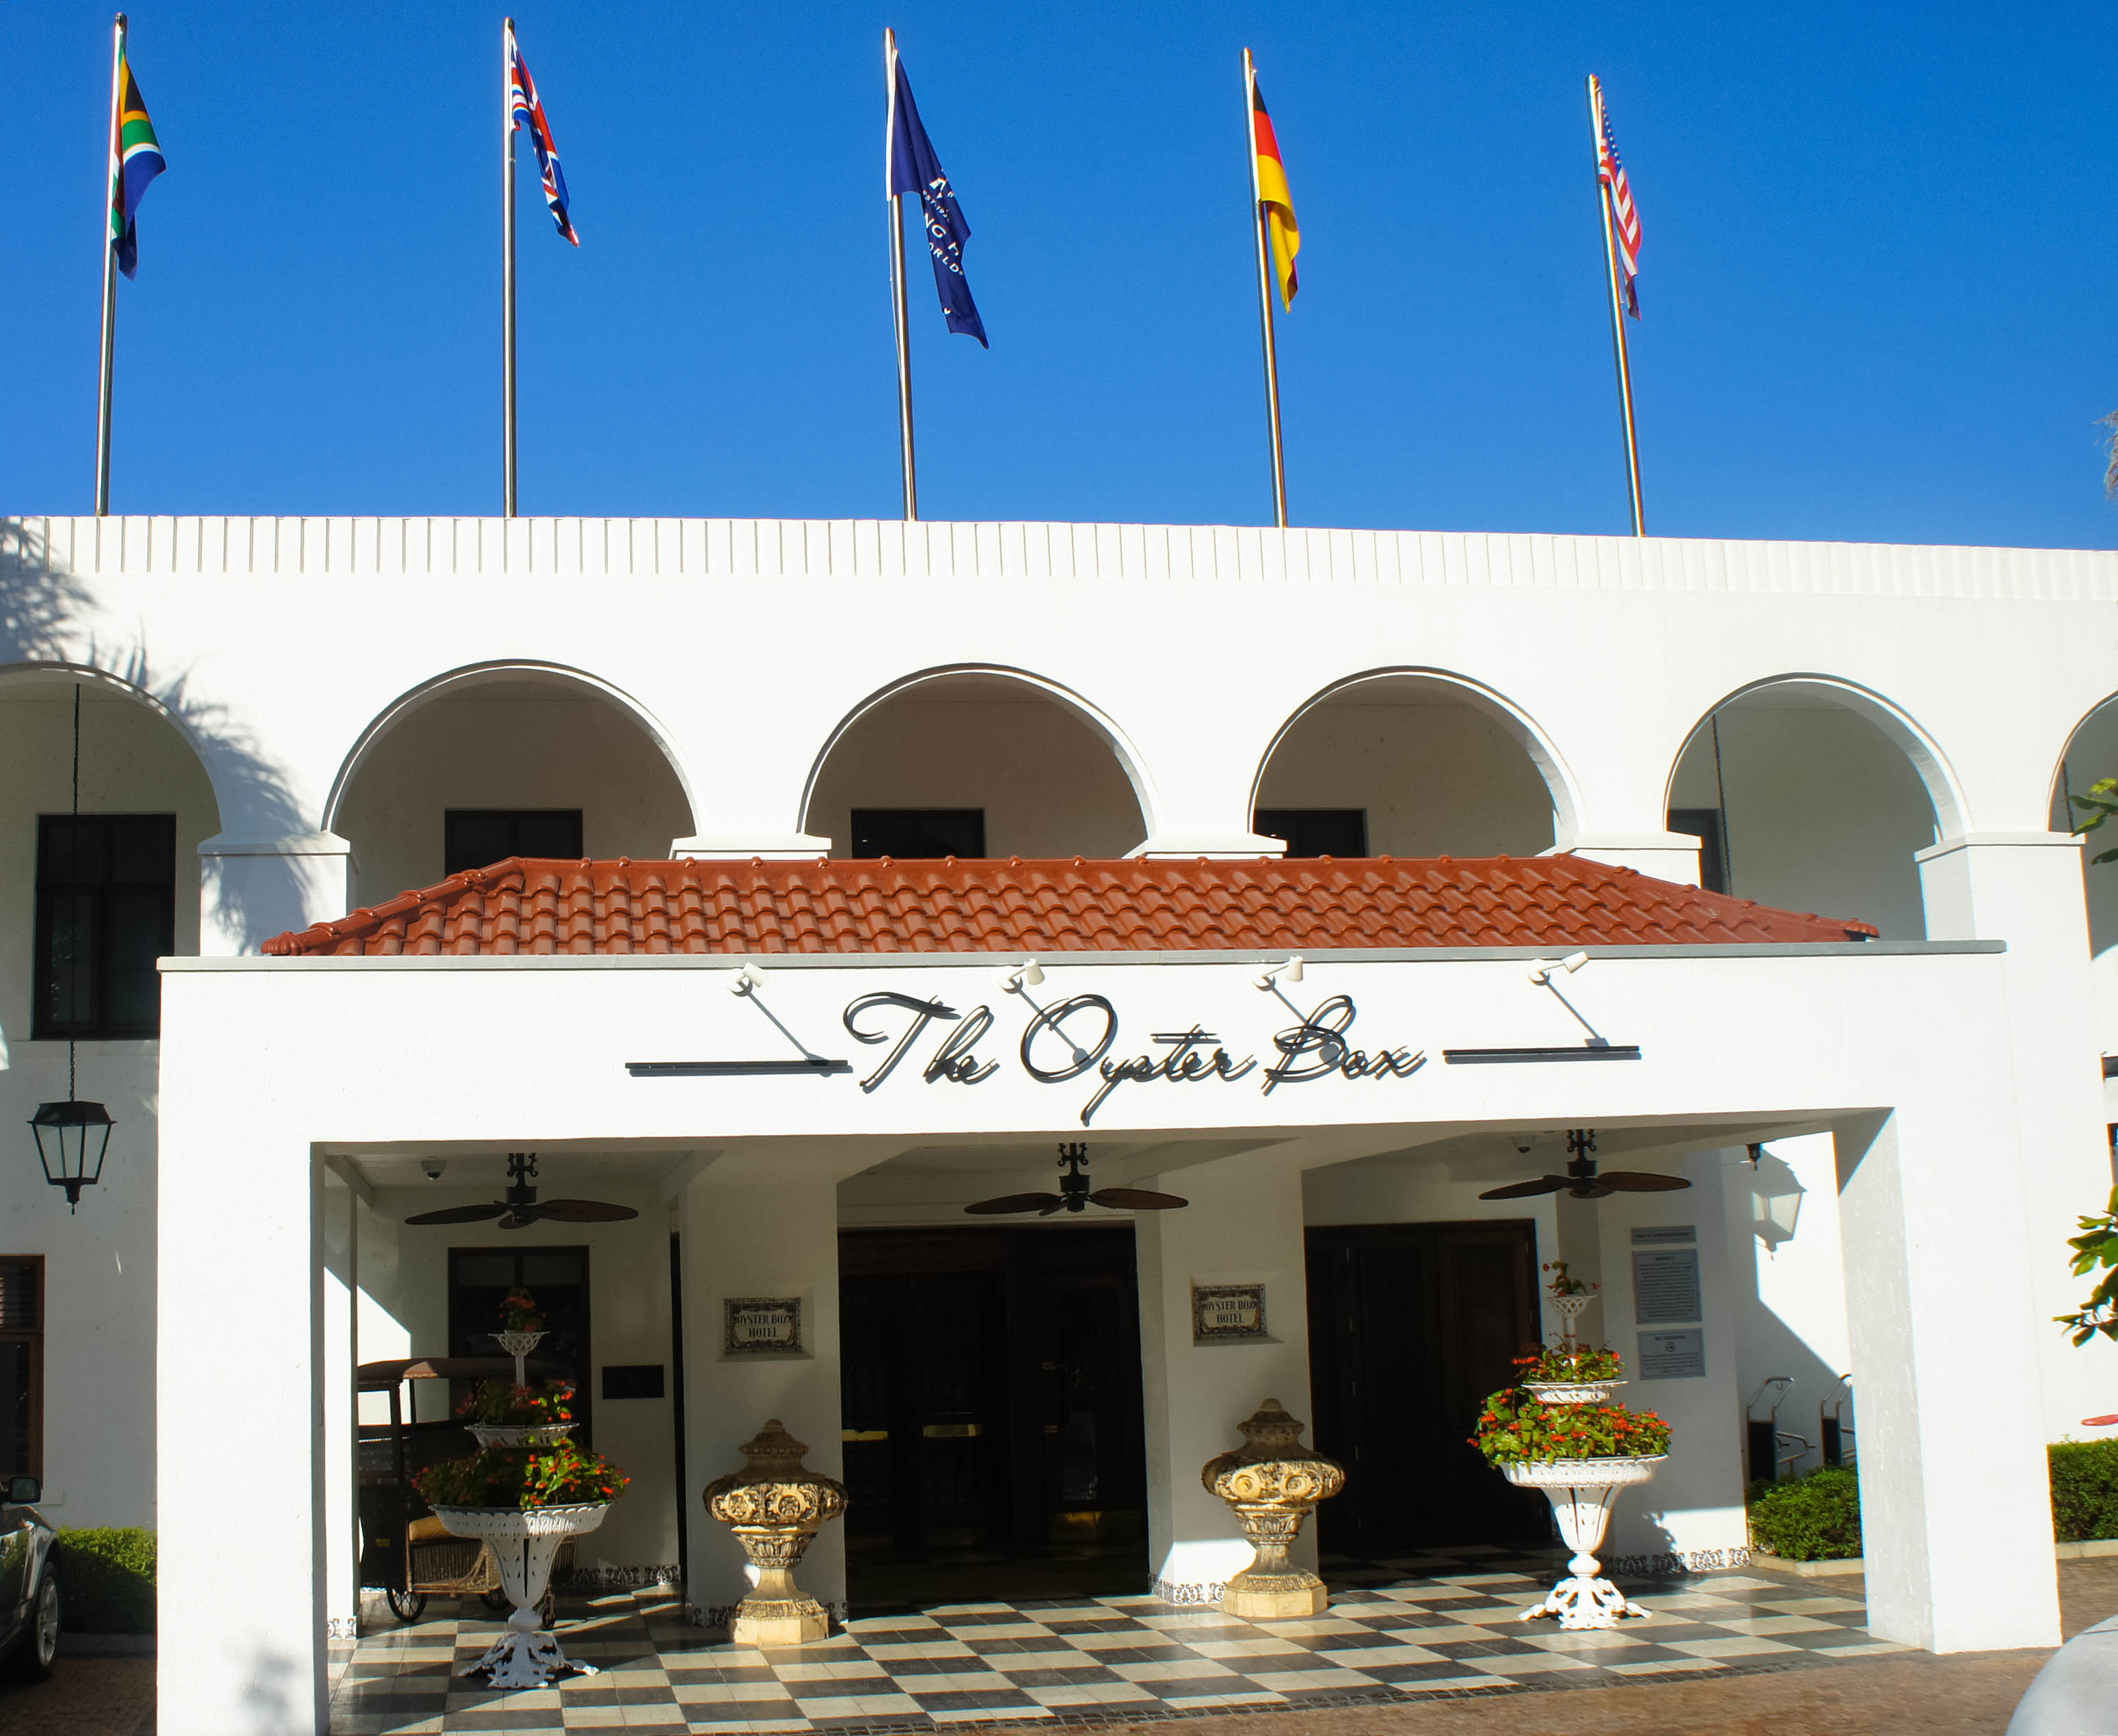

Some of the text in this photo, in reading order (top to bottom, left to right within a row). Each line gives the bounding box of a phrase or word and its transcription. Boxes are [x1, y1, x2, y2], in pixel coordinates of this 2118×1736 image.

[928, 241, 961, 273] ORLD
[843, 991, 1425, 1125] The Oyster Box
[1205, 1300, 1254, 1311] OYSTER BOX
[738, 1313, 788, 1325] OYSTER BOX
[1216, 1313, 1244, 1324] HOTEL
[749, 1326, 779, 1337] HOTEL
